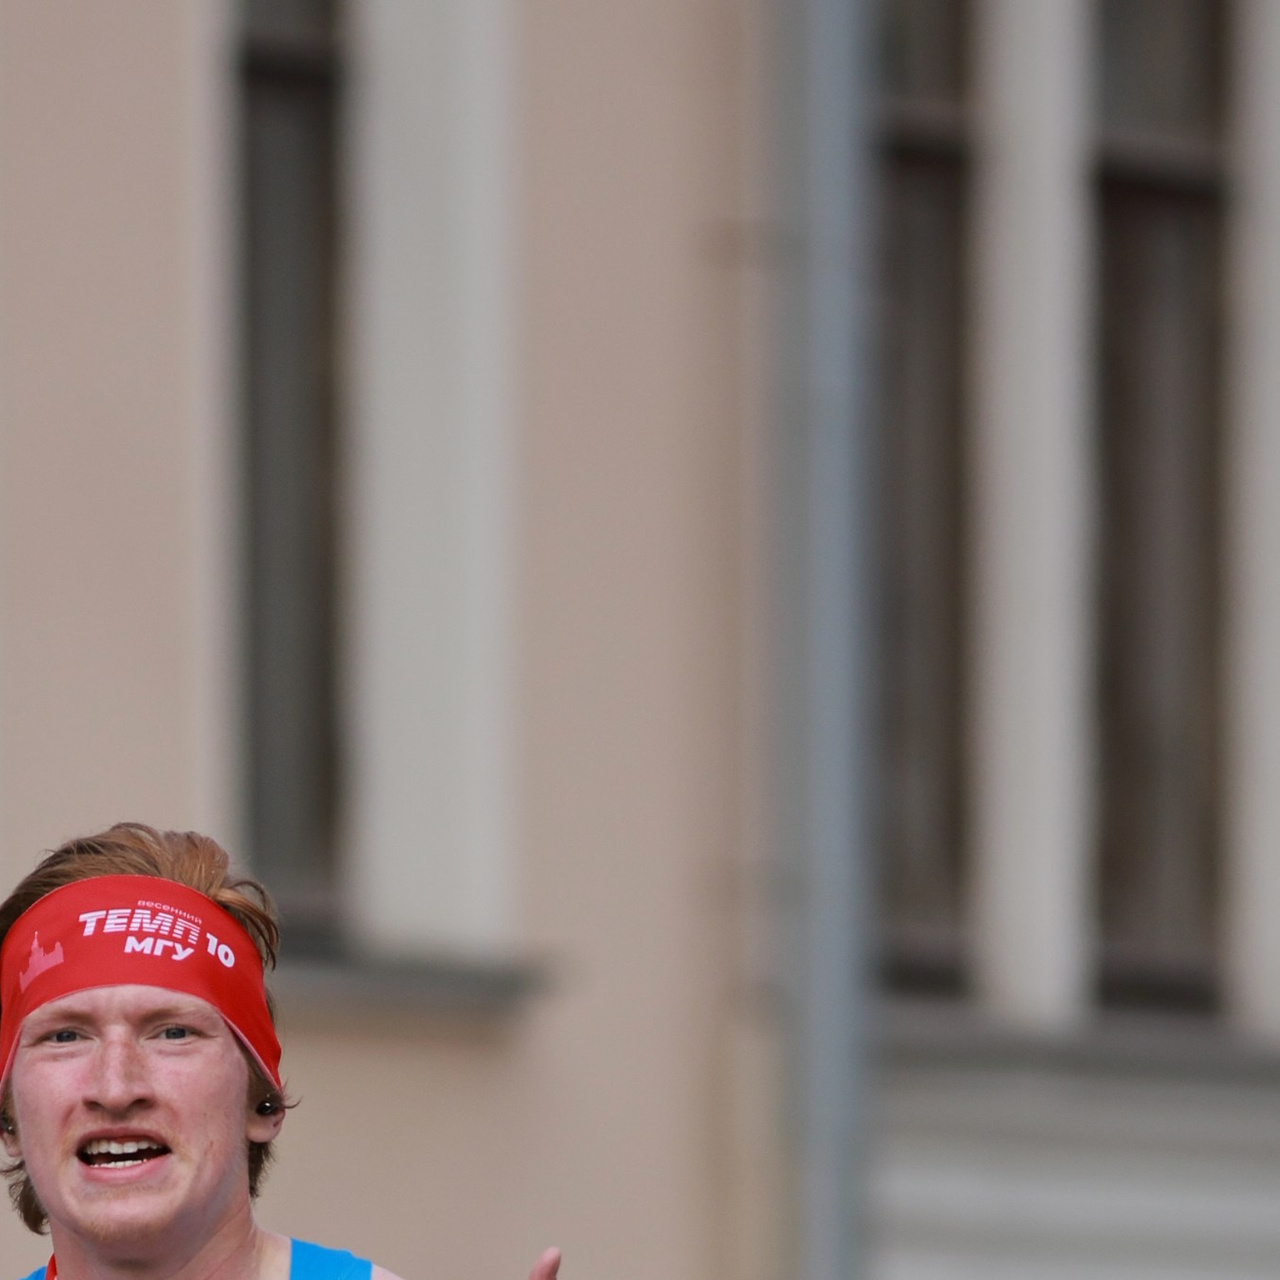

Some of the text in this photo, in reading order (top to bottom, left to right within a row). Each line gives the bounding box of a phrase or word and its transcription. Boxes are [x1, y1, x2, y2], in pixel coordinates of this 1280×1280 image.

[79, 908, 201, 945] ТЕМП
[137, 899, 202, 925] весенний
[124, 936, 195, 961] МГУ
[206, 932, 236, 968] 10
